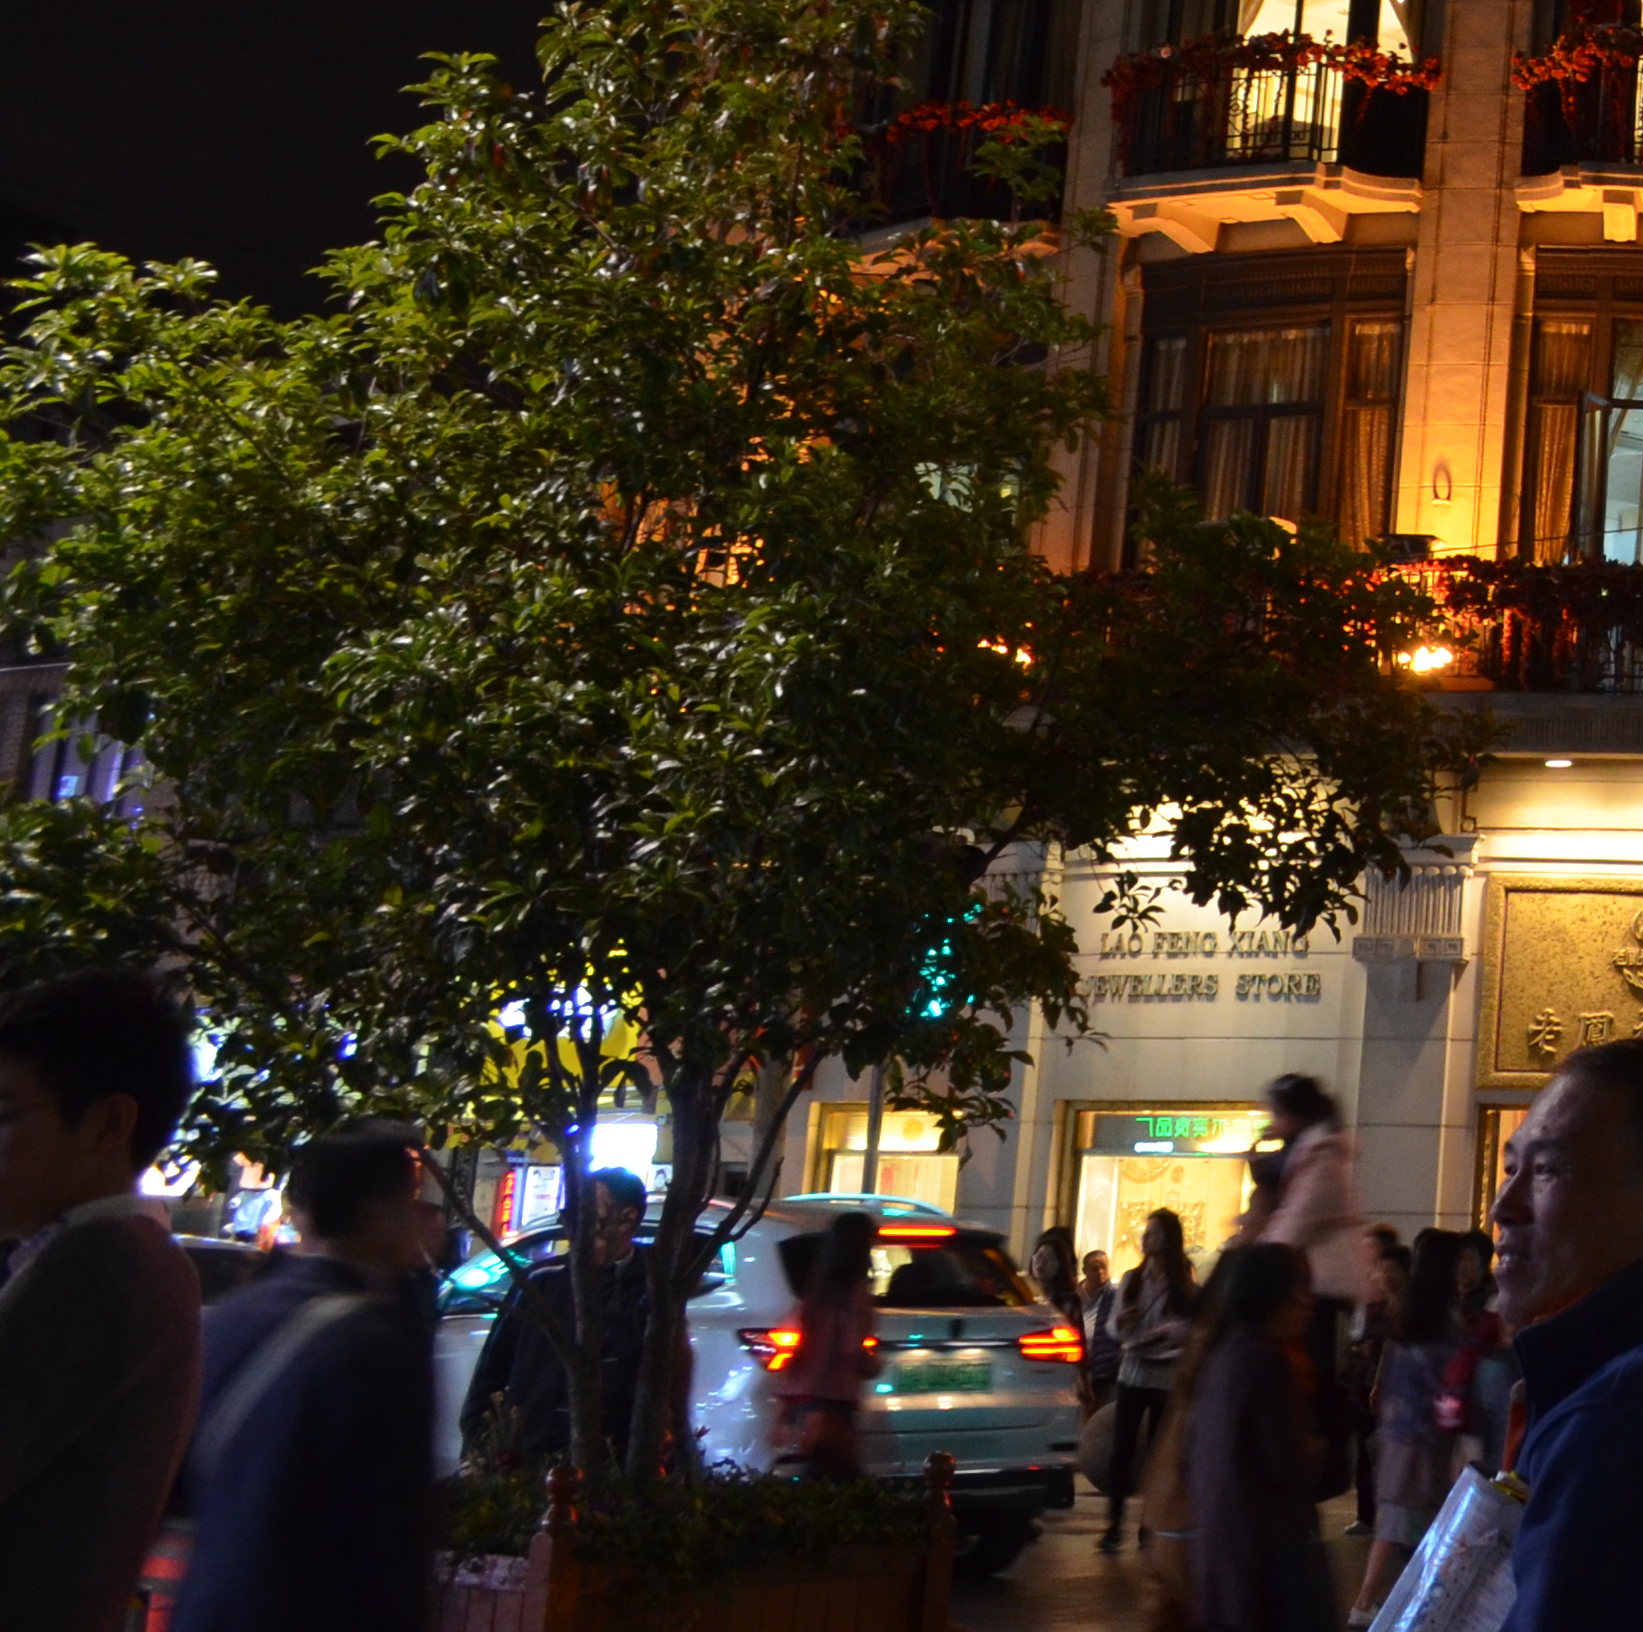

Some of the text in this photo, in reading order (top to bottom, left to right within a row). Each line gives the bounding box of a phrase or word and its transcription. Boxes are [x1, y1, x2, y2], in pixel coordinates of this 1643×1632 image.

[1100, 931, 1143, 956] LAO
[1152, 930, 1218, 955] FENG
[1235, 973, 1322, 998] STORE
